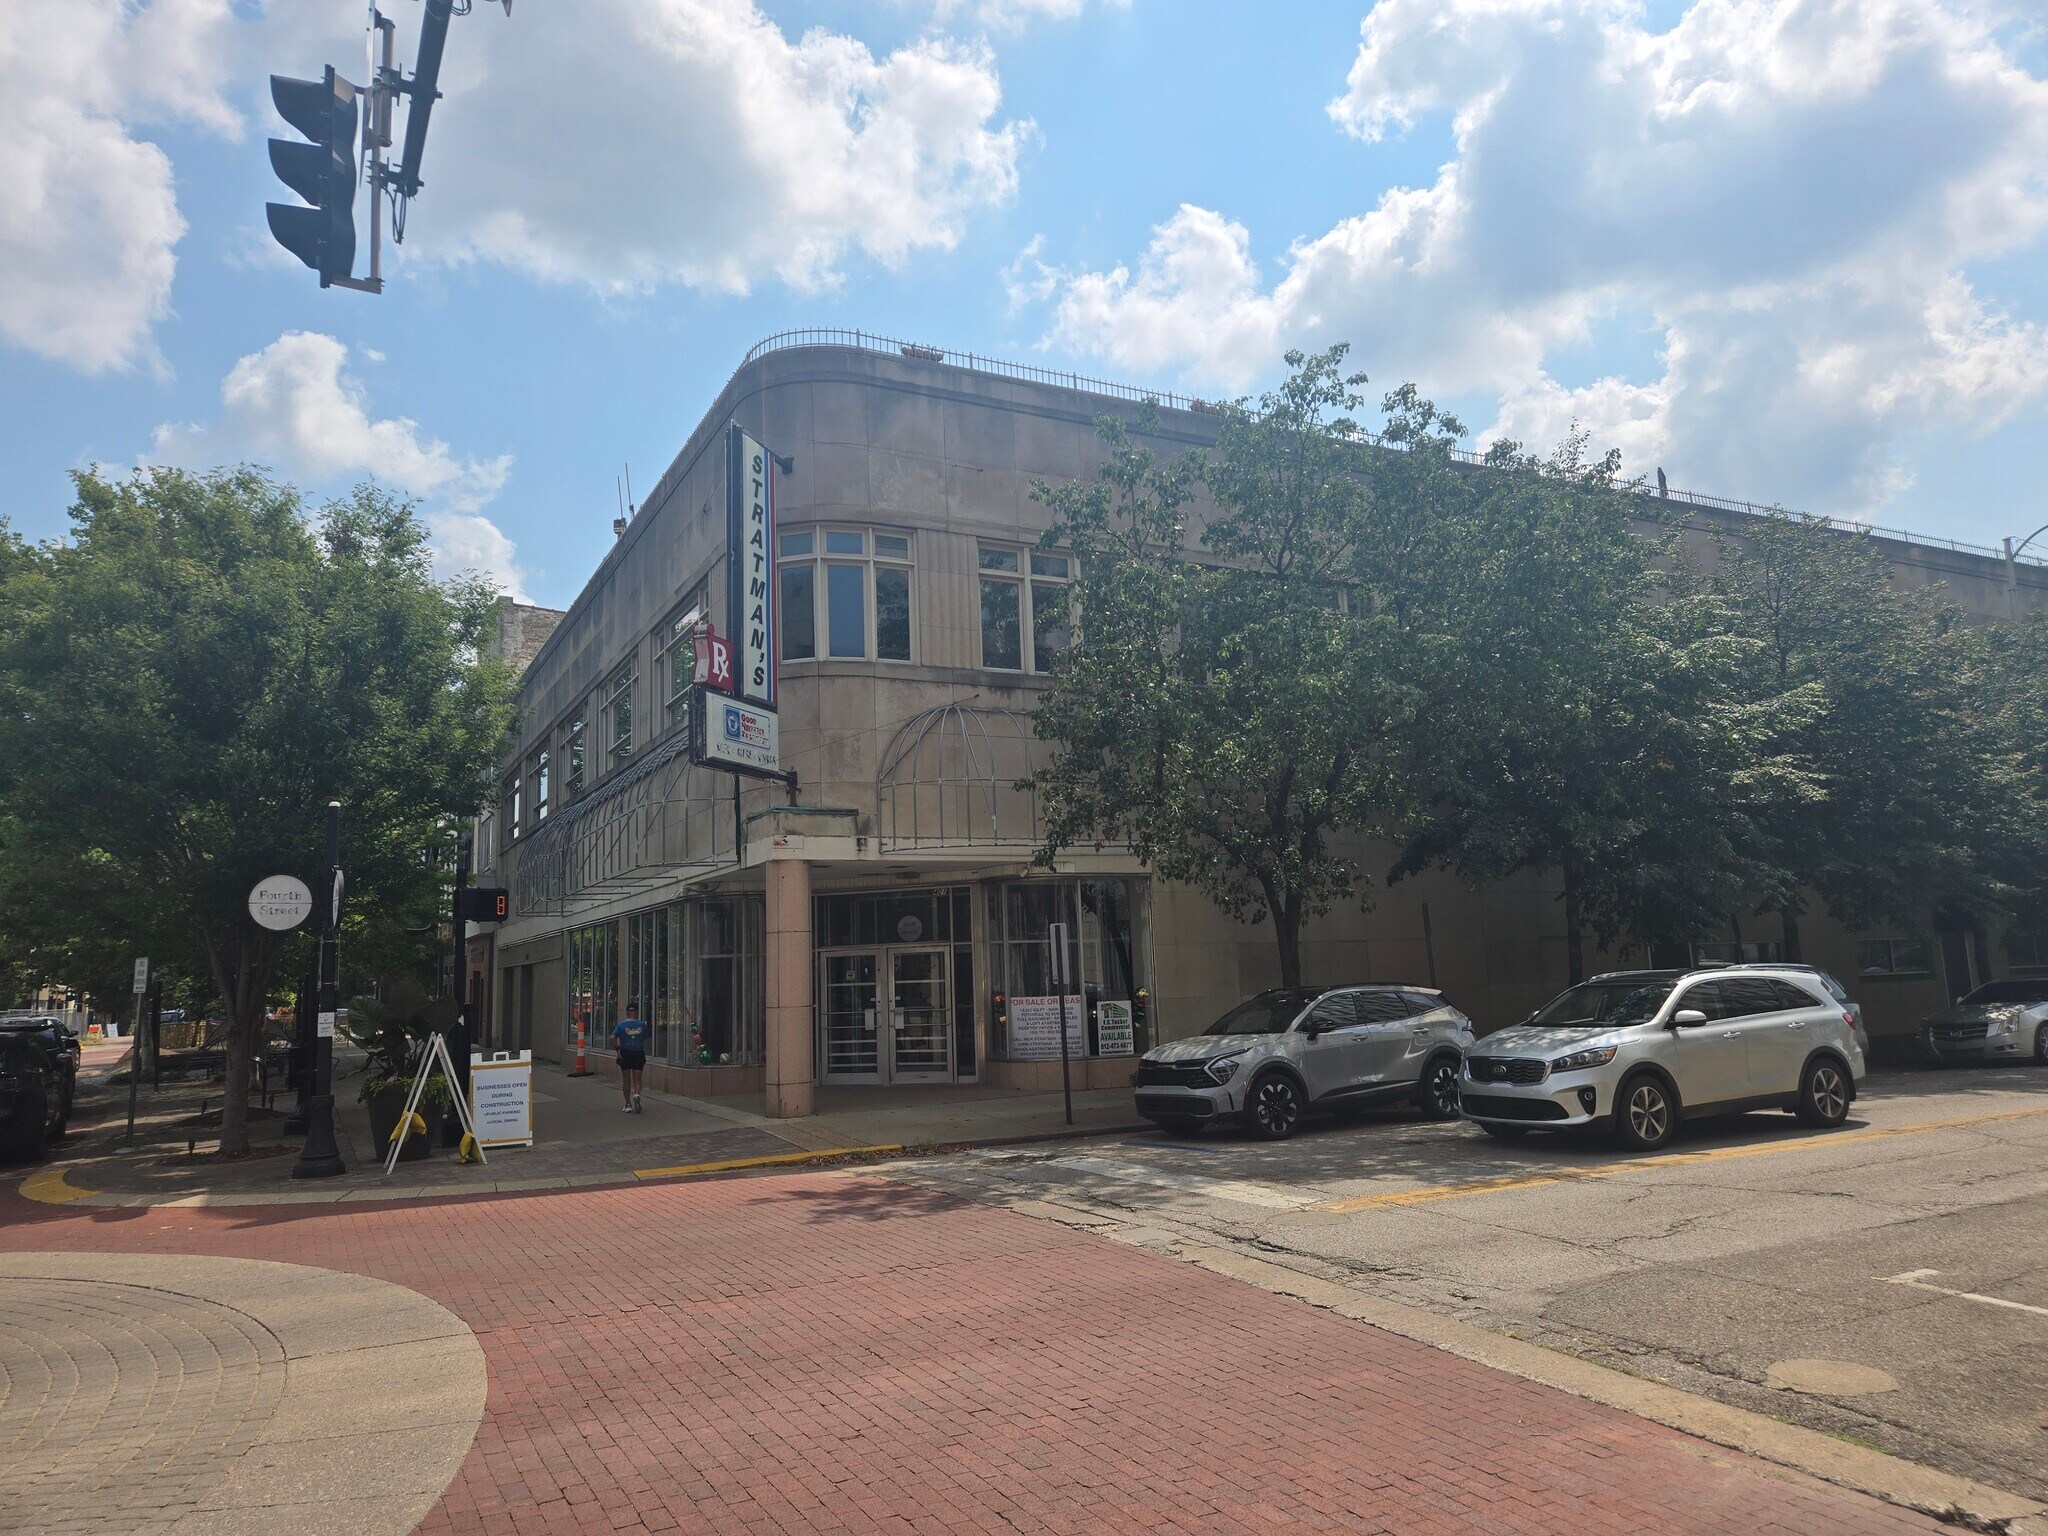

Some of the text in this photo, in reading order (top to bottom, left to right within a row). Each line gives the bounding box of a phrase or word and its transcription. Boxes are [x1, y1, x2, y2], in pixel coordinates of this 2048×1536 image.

[750, 455, 766, 687] STRATMAN'S
[260, 890, 302, 900] Fourth
[260, 905, 301, 915] Street
[1025, 998, 1045, 1006] SALE
[1047, 997, 1059, 1005] OR
[1101, 1032, 1132, 1041] AVAILABLE
